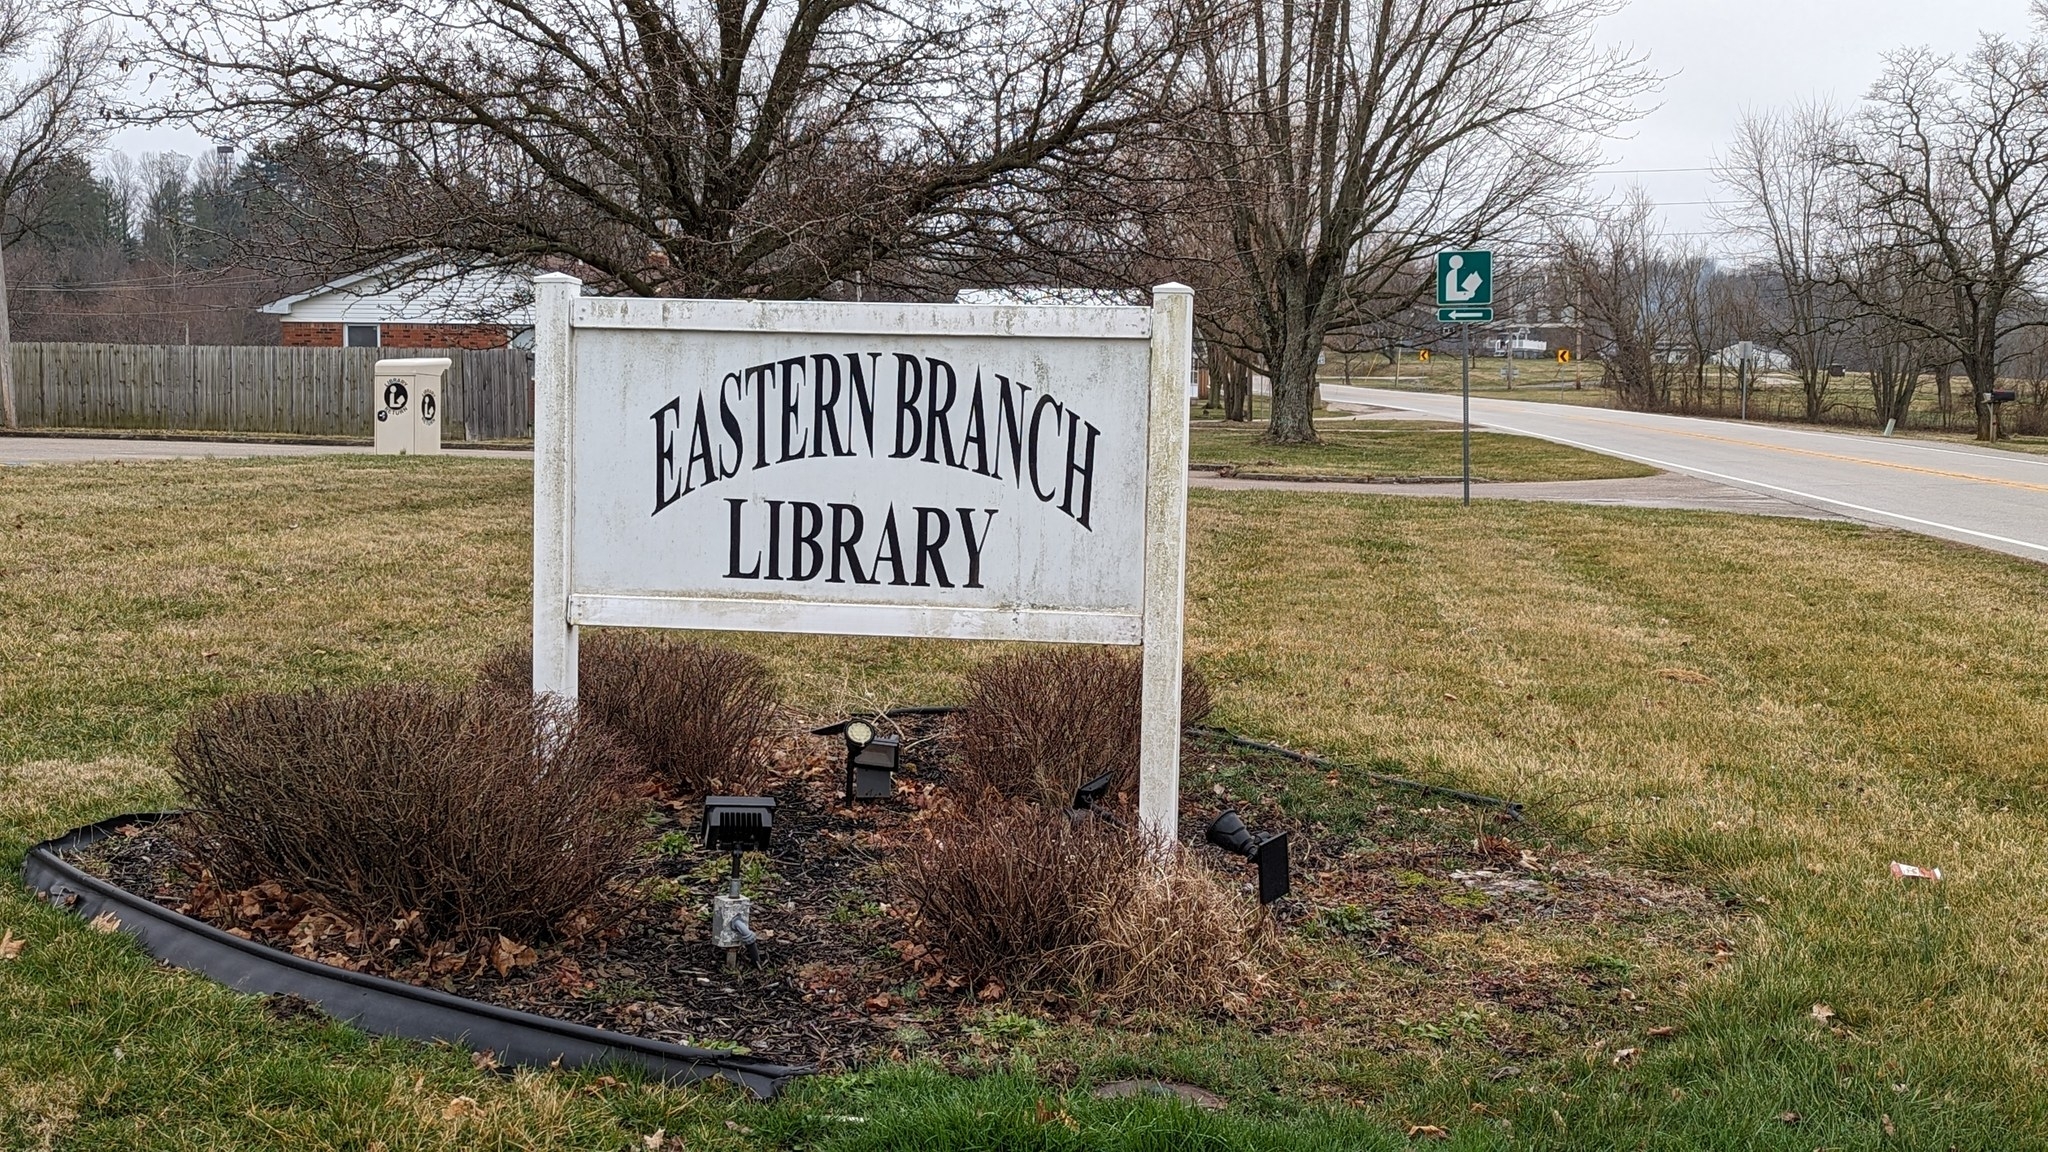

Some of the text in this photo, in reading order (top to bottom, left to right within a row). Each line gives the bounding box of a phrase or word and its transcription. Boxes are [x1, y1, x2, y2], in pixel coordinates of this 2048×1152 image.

[384, 378, 408, 387] LIBRARY
[384, 406, 408, 416] RETURN
[650, 352, 1101, 533] EASTERN BRANCH
[722, 498, 999, 589] LIBRARY
